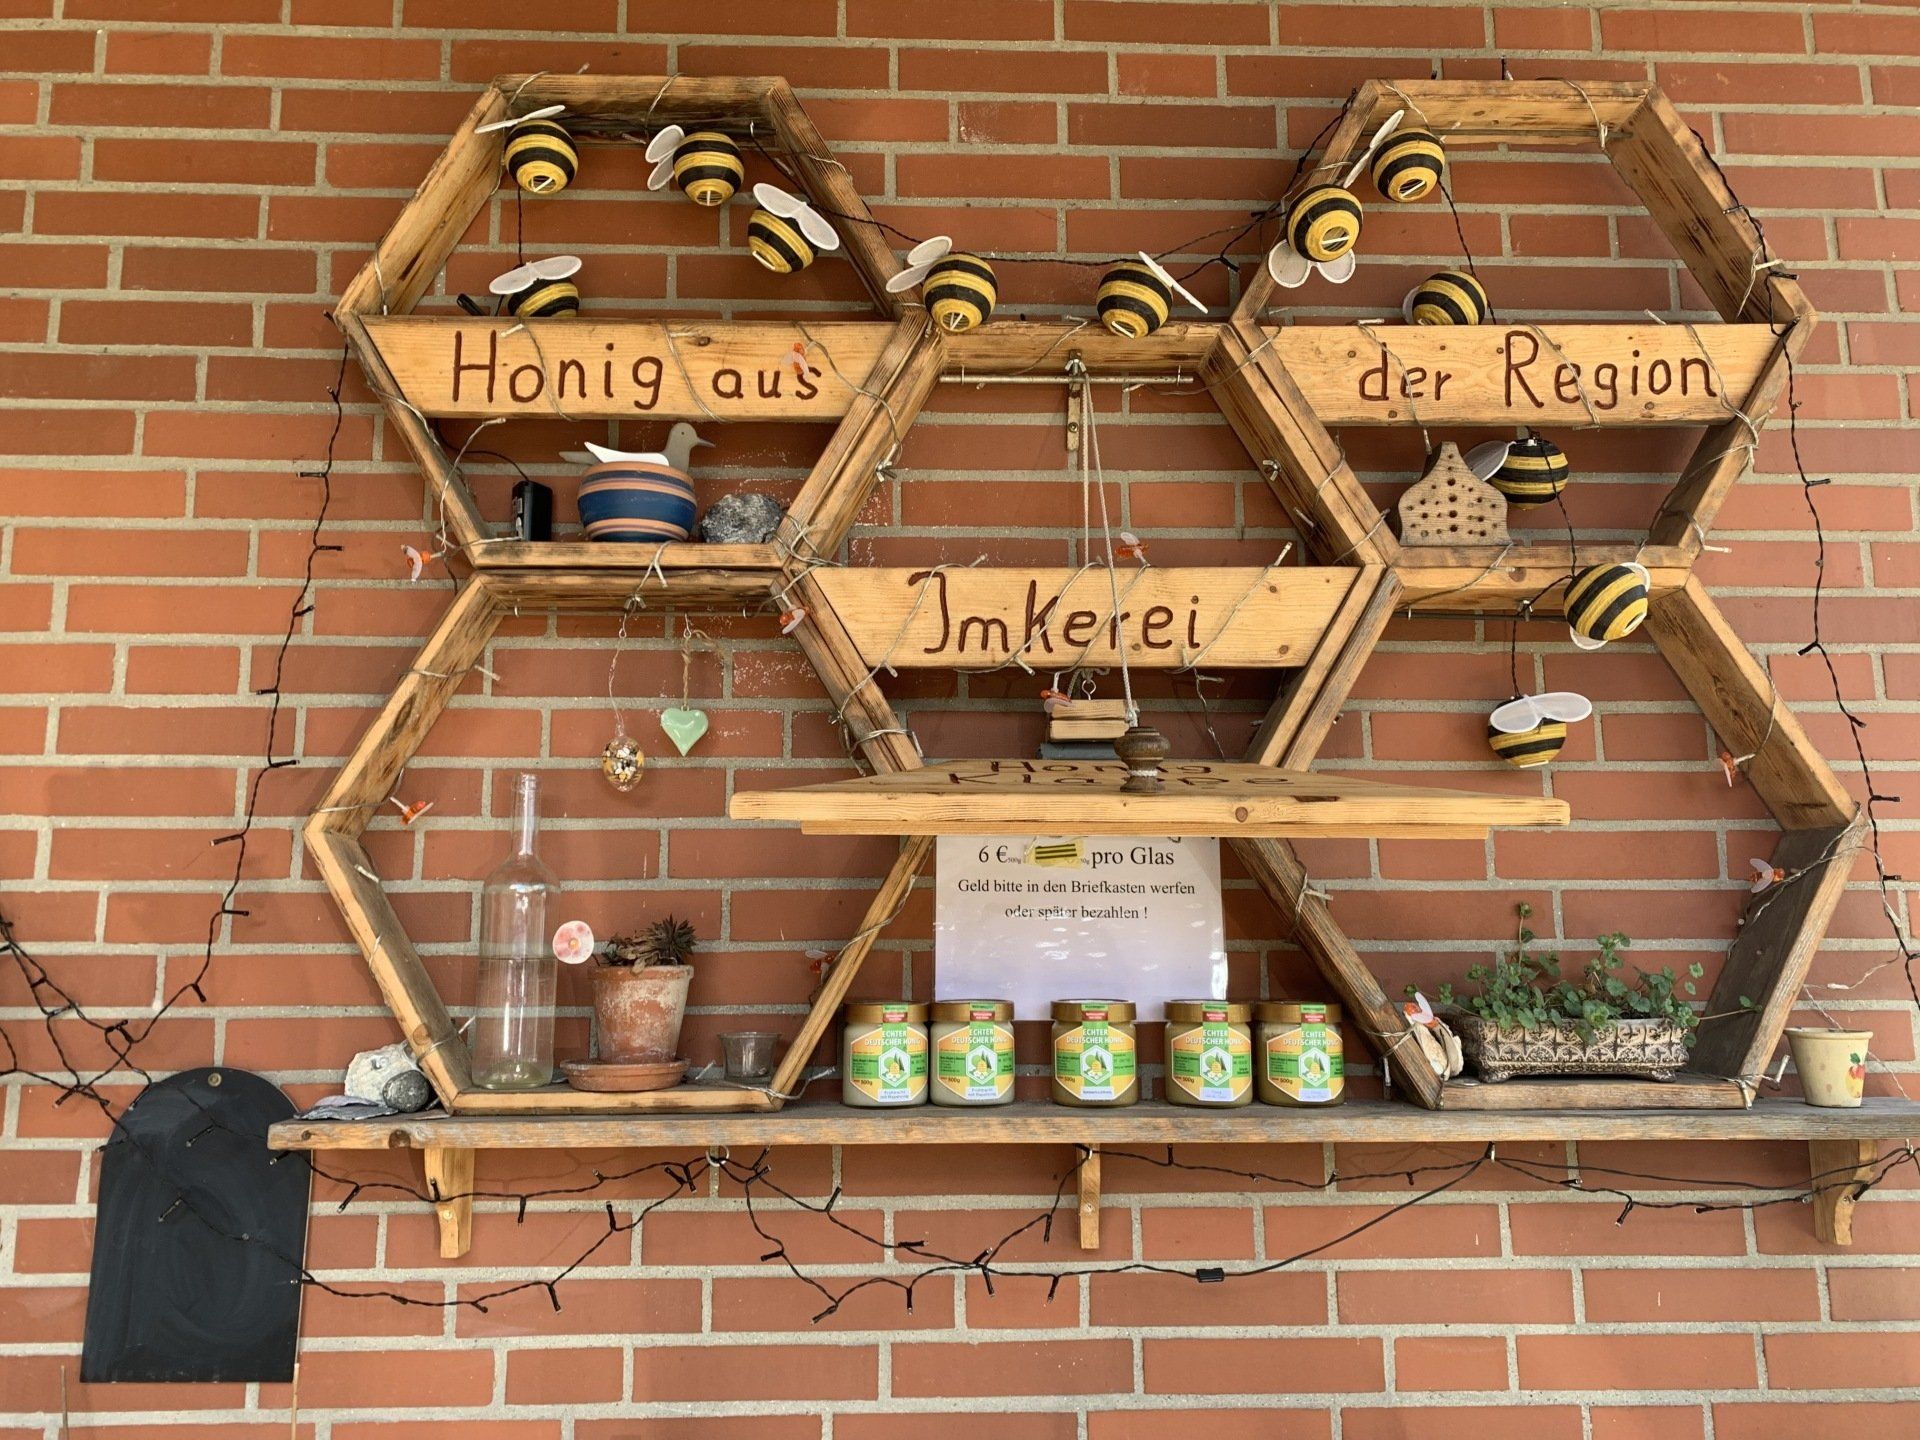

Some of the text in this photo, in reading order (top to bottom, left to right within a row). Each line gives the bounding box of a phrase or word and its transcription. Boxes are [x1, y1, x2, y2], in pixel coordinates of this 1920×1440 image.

[452, 329, 822, 411] Honig aus
[1358, 329, 1718, 411] der Region
[978, 845, 989, 863] 6
[1092, 850, 1123, 869] pro
[1130, 846, 1174, 865] Glas
[958, 878, 1196, 895] Geld bitte in den Briefkasten werfen
[1005, 905, 1149, 921] oder später bezahlen !
[881, 1030, 907, 1038] ECHTER
[969, 1028, 994, 1037] ECHTER
[1082, 1028, 1108, 1036] ECHTER
[1202, 1029, 1228, 1037] ECHTER
[1301, 1031, 1326, 1039] ECHTER
